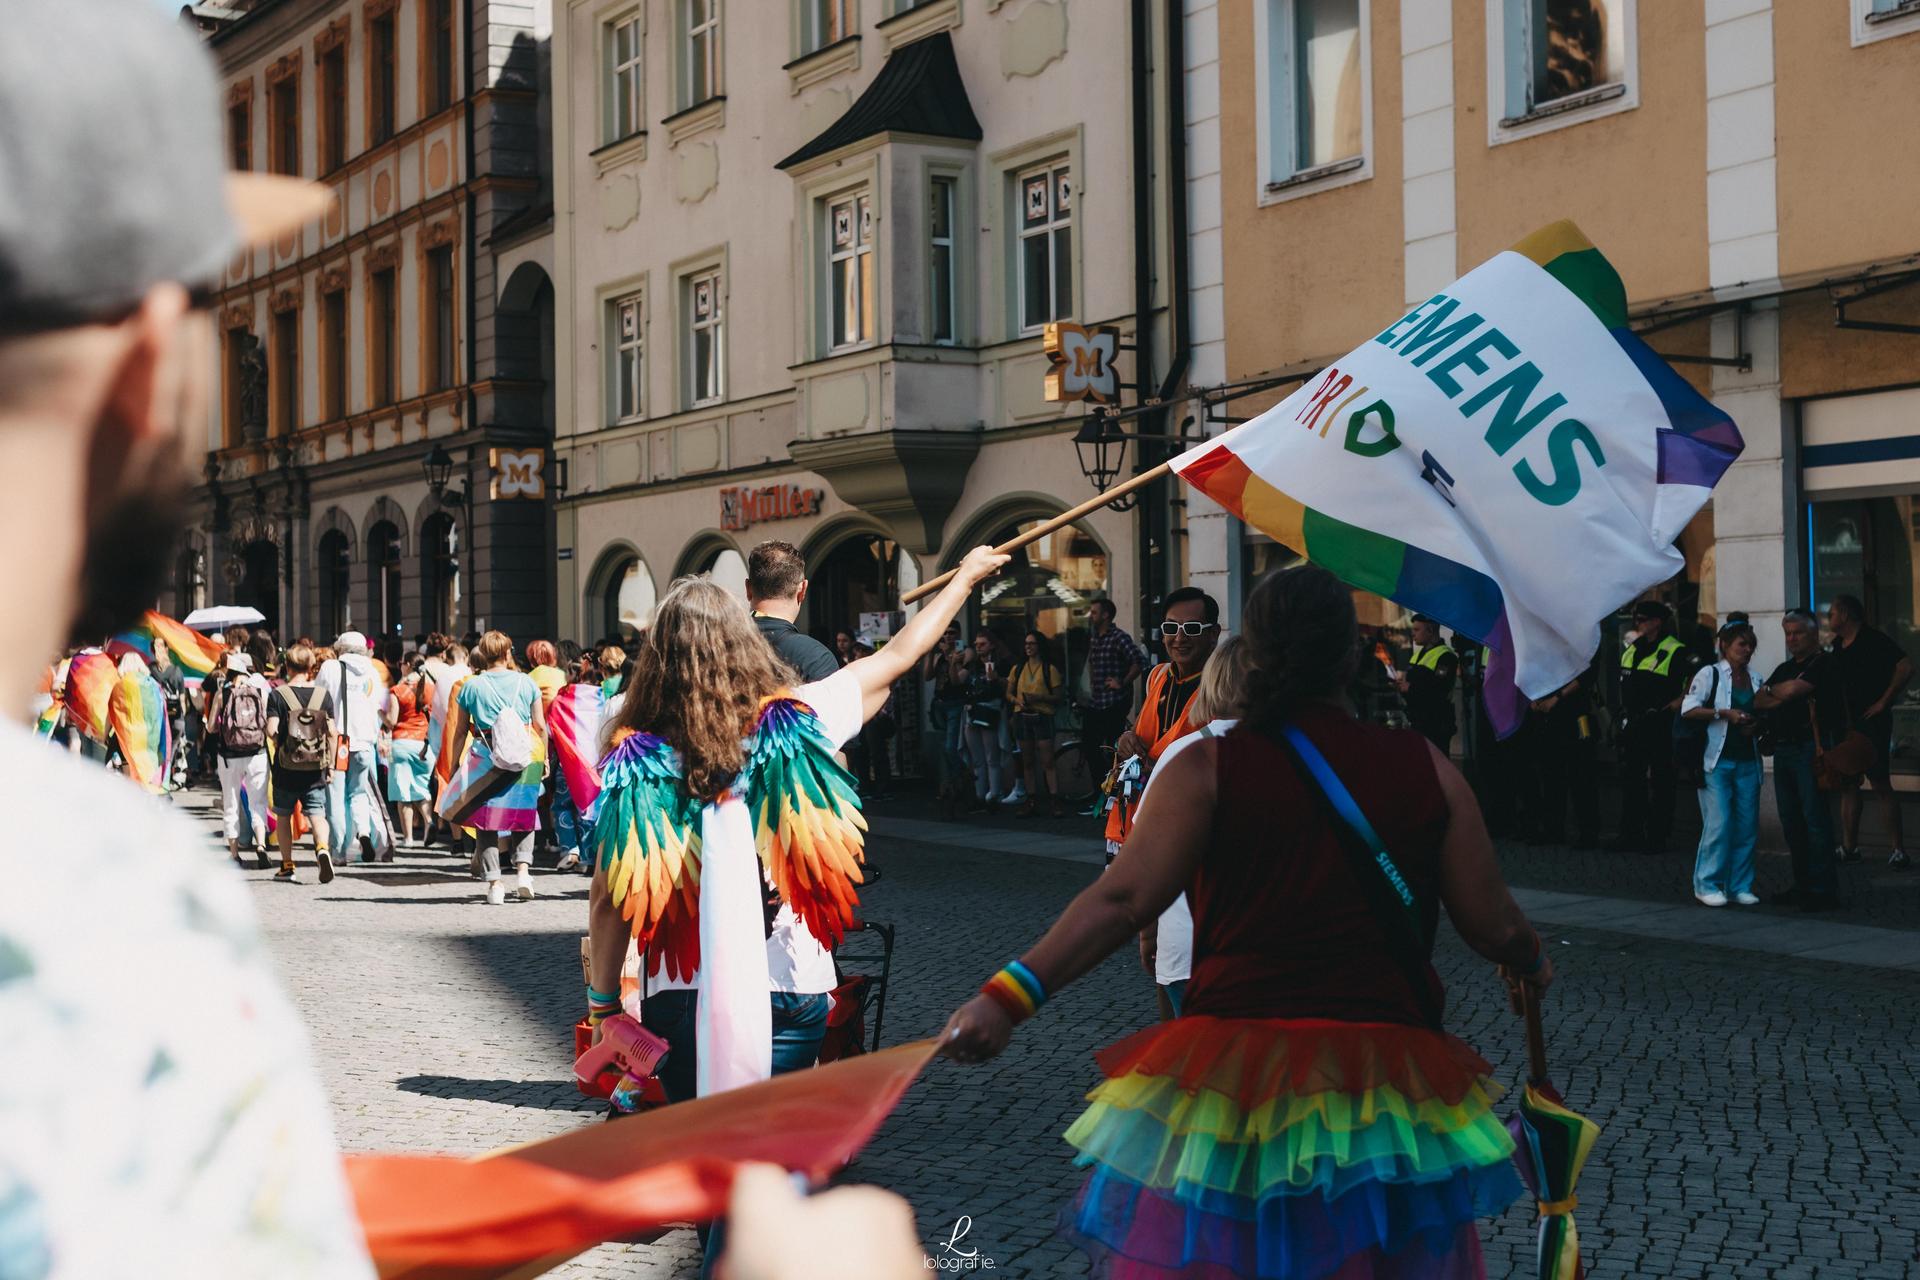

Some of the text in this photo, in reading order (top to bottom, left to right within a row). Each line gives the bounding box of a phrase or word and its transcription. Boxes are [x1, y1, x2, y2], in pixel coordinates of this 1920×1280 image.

[1073, 345, 1104, 378] M
[508, 463, 531, 484] M
[740, 484, 816, 524] Müller
[1375, 852, 1414, 906] SIEMENS
